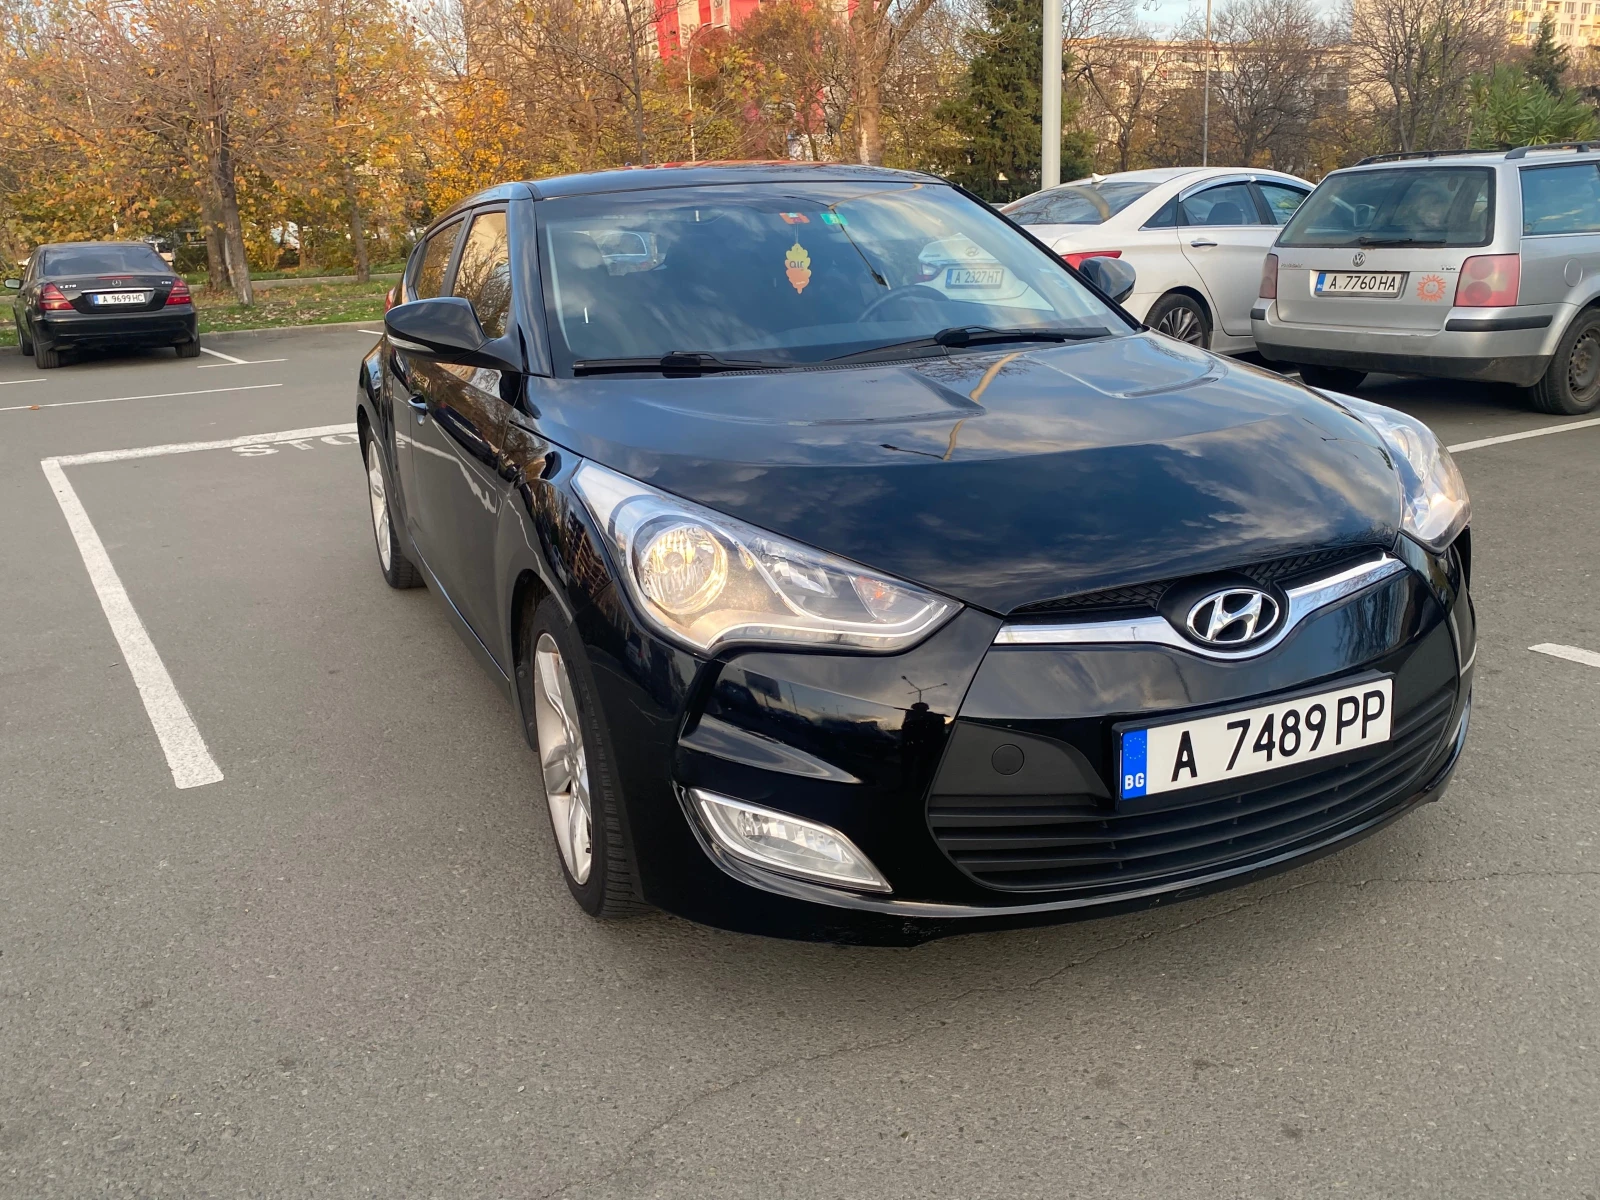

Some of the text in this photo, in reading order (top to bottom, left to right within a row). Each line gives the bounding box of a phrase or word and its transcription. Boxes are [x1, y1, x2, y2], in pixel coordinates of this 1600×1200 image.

[955, 271, 1000, 283] A 2327 HT
[1329, 275, 1396, 291] A 7760 HA
[103, 293, 144, 303] A 9699 HC
[1171, 689, 1385, 782] A 7489 PP
[1124, 772, 1145, 790] BG
